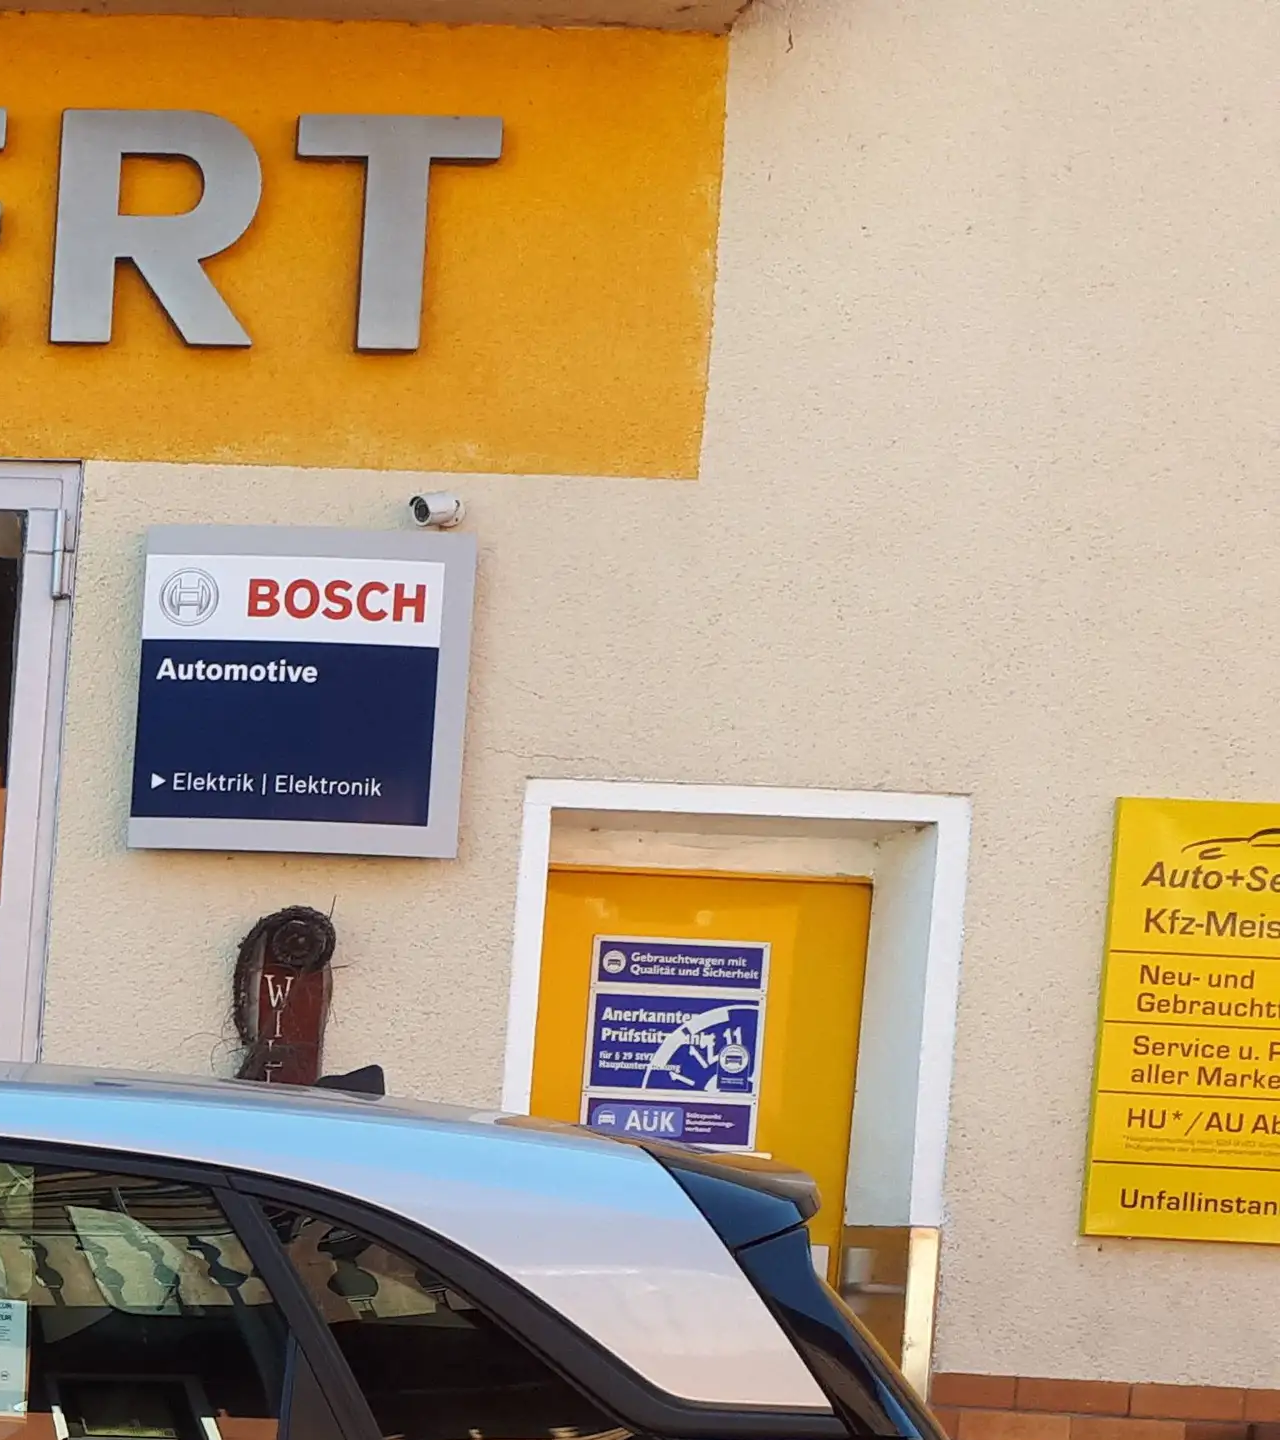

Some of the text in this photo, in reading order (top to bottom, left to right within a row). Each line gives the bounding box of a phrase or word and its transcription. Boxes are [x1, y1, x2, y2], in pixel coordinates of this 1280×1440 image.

[247, 578, 427, 623] BOSCH
[156, 657, 318, 684] Automotive
[172, 771, 254, 793] Elektrik
[274, 774, 383, 797] Elektronik
[630, 965, 759, 980] Qualität und Sicherheit
[631, 952, 747, 968] Gebrauchtwagen mit
[1139, 964, 1255, 990] Neu- und
[1136, 992, 1280, 1019] Gebraucht
[1132, 1035, 1230, 1061] Service
[1238, 1043, 1260, 1062] u.
[1130, 1065, 1189, 1087] aller
[624, 1109, 675, 1132] AÜK
[1120, 1188, 1280, 1218] Unfallinstan
